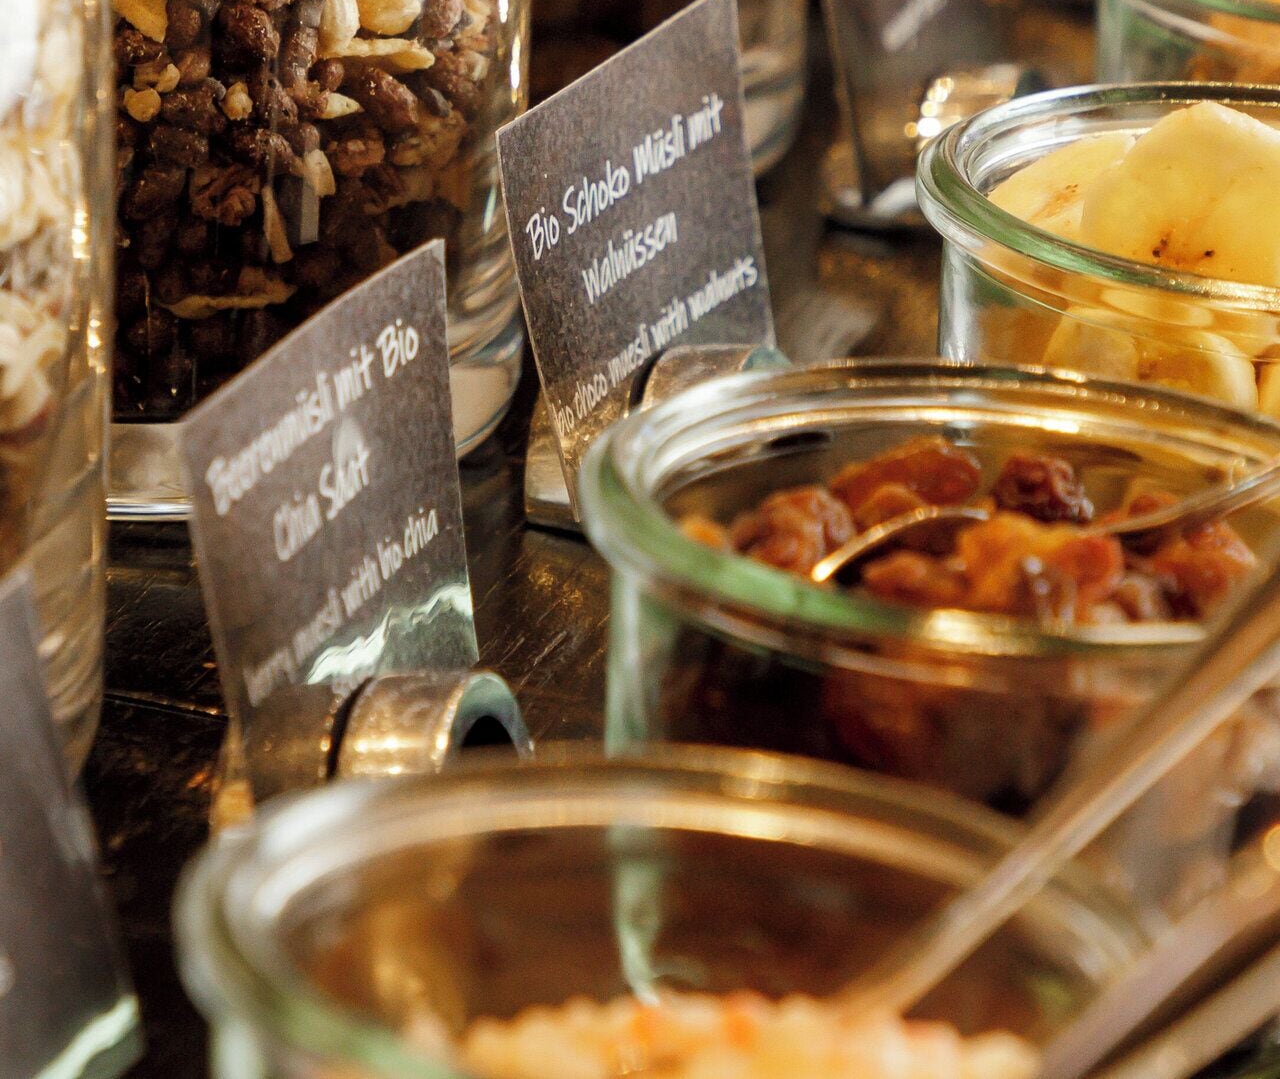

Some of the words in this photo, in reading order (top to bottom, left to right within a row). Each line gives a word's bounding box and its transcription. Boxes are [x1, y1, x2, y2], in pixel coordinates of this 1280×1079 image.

[527, 207, 560, 260] Bio
[563, 161, 630, 235] Schoko
[633, 114, 684, 186] Müsli
[687, 93, 723, 150] mit
[583, 211, 678, 304] Walnüssen
[551, 399, 575, 436] bio
[573, 373, 608, 420] choco
[608, 323, 651, 388] muesli
[650, 296, 688, 350] with
[687, 255, 758, 321] walnuts
[204, 369, 333, 517] Beerenmüsli
[333, 342, 374, 412] mit
[376, 318, 419, 378] Bio
[272, 488, 320, 561] Chia
[341, 555, 381, 617] with
[377, 537, 403, 580] bio
[404, 507, 439, 558] chia
